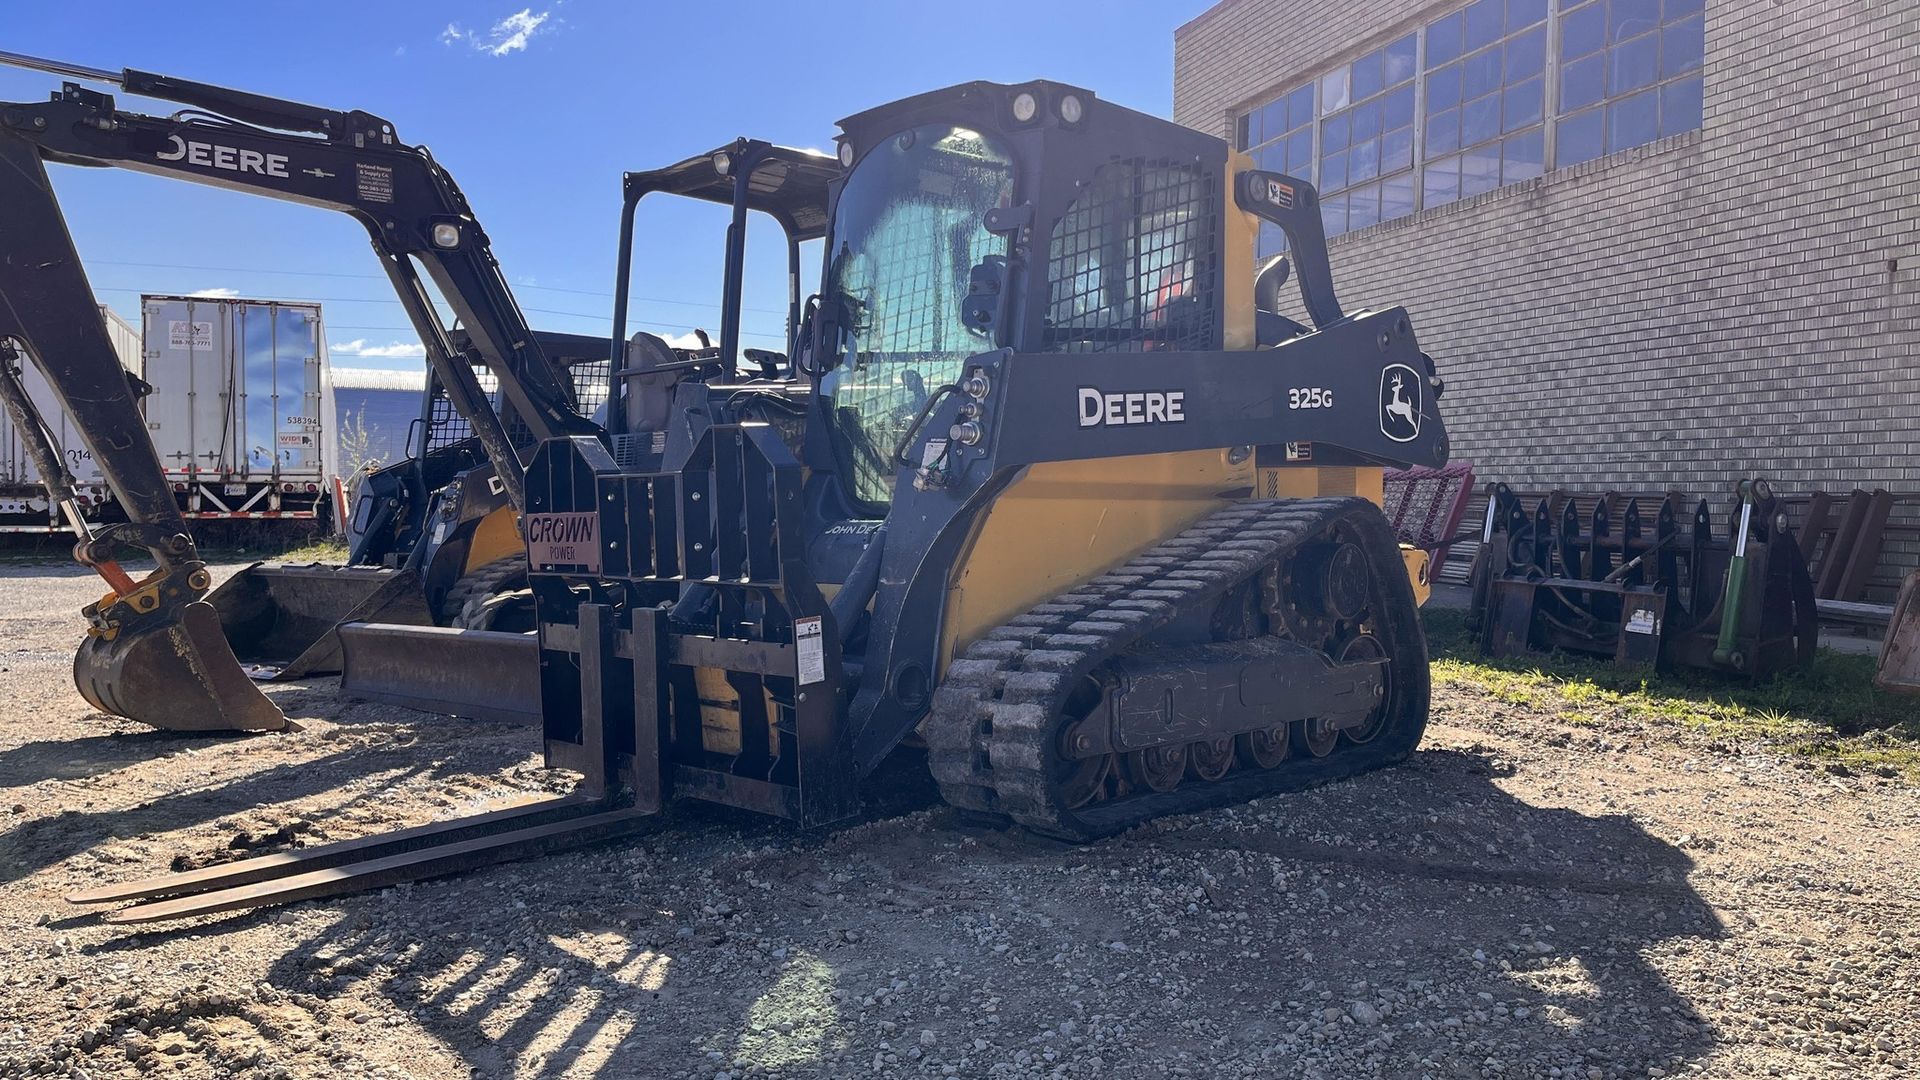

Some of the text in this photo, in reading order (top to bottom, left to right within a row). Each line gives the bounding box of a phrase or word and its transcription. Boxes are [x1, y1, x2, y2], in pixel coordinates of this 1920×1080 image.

[1078, 387, 1185, 427] DEERE
[1288, 387, 1333, 410] 325G
[287, 416, 318, 425] 538394
[530, 516, 594, 543] CROWN
[824, 525, 857, 535] JOHN
[549, 545, 577, 561] POWER
